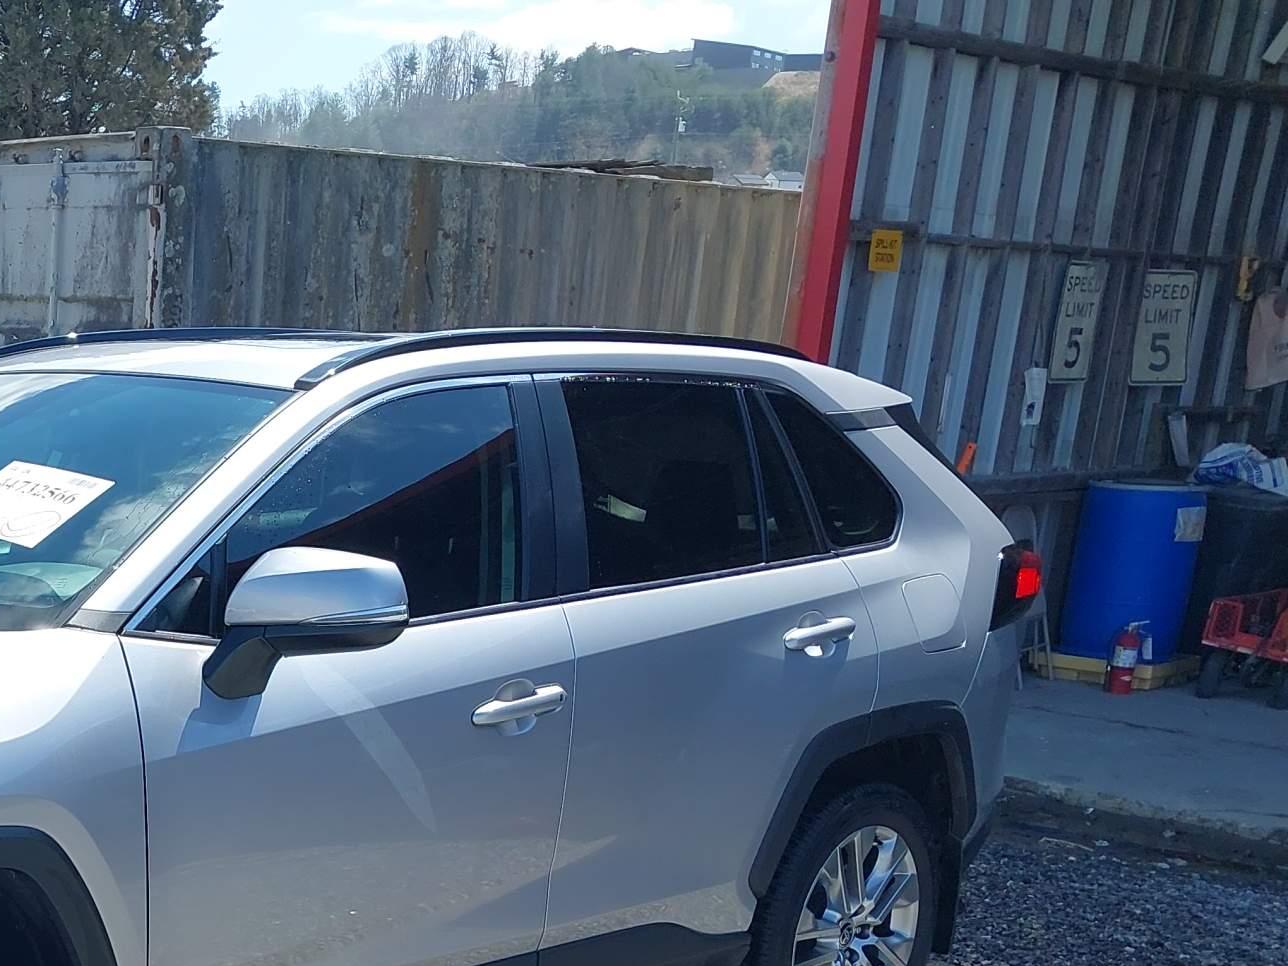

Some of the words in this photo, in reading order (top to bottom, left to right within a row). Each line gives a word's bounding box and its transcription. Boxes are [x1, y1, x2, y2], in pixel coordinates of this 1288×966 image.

[1066, 276, 1103, 293] SPEED
[1143, 284, 1190, 300] SPEED
[1064, 302, 1095, 318] LIMIT
[1144, 308, 1182, 325] LIMIT
[1063, 327, 1084, 369] 5
[1147, 331, 1170, 372] 5
